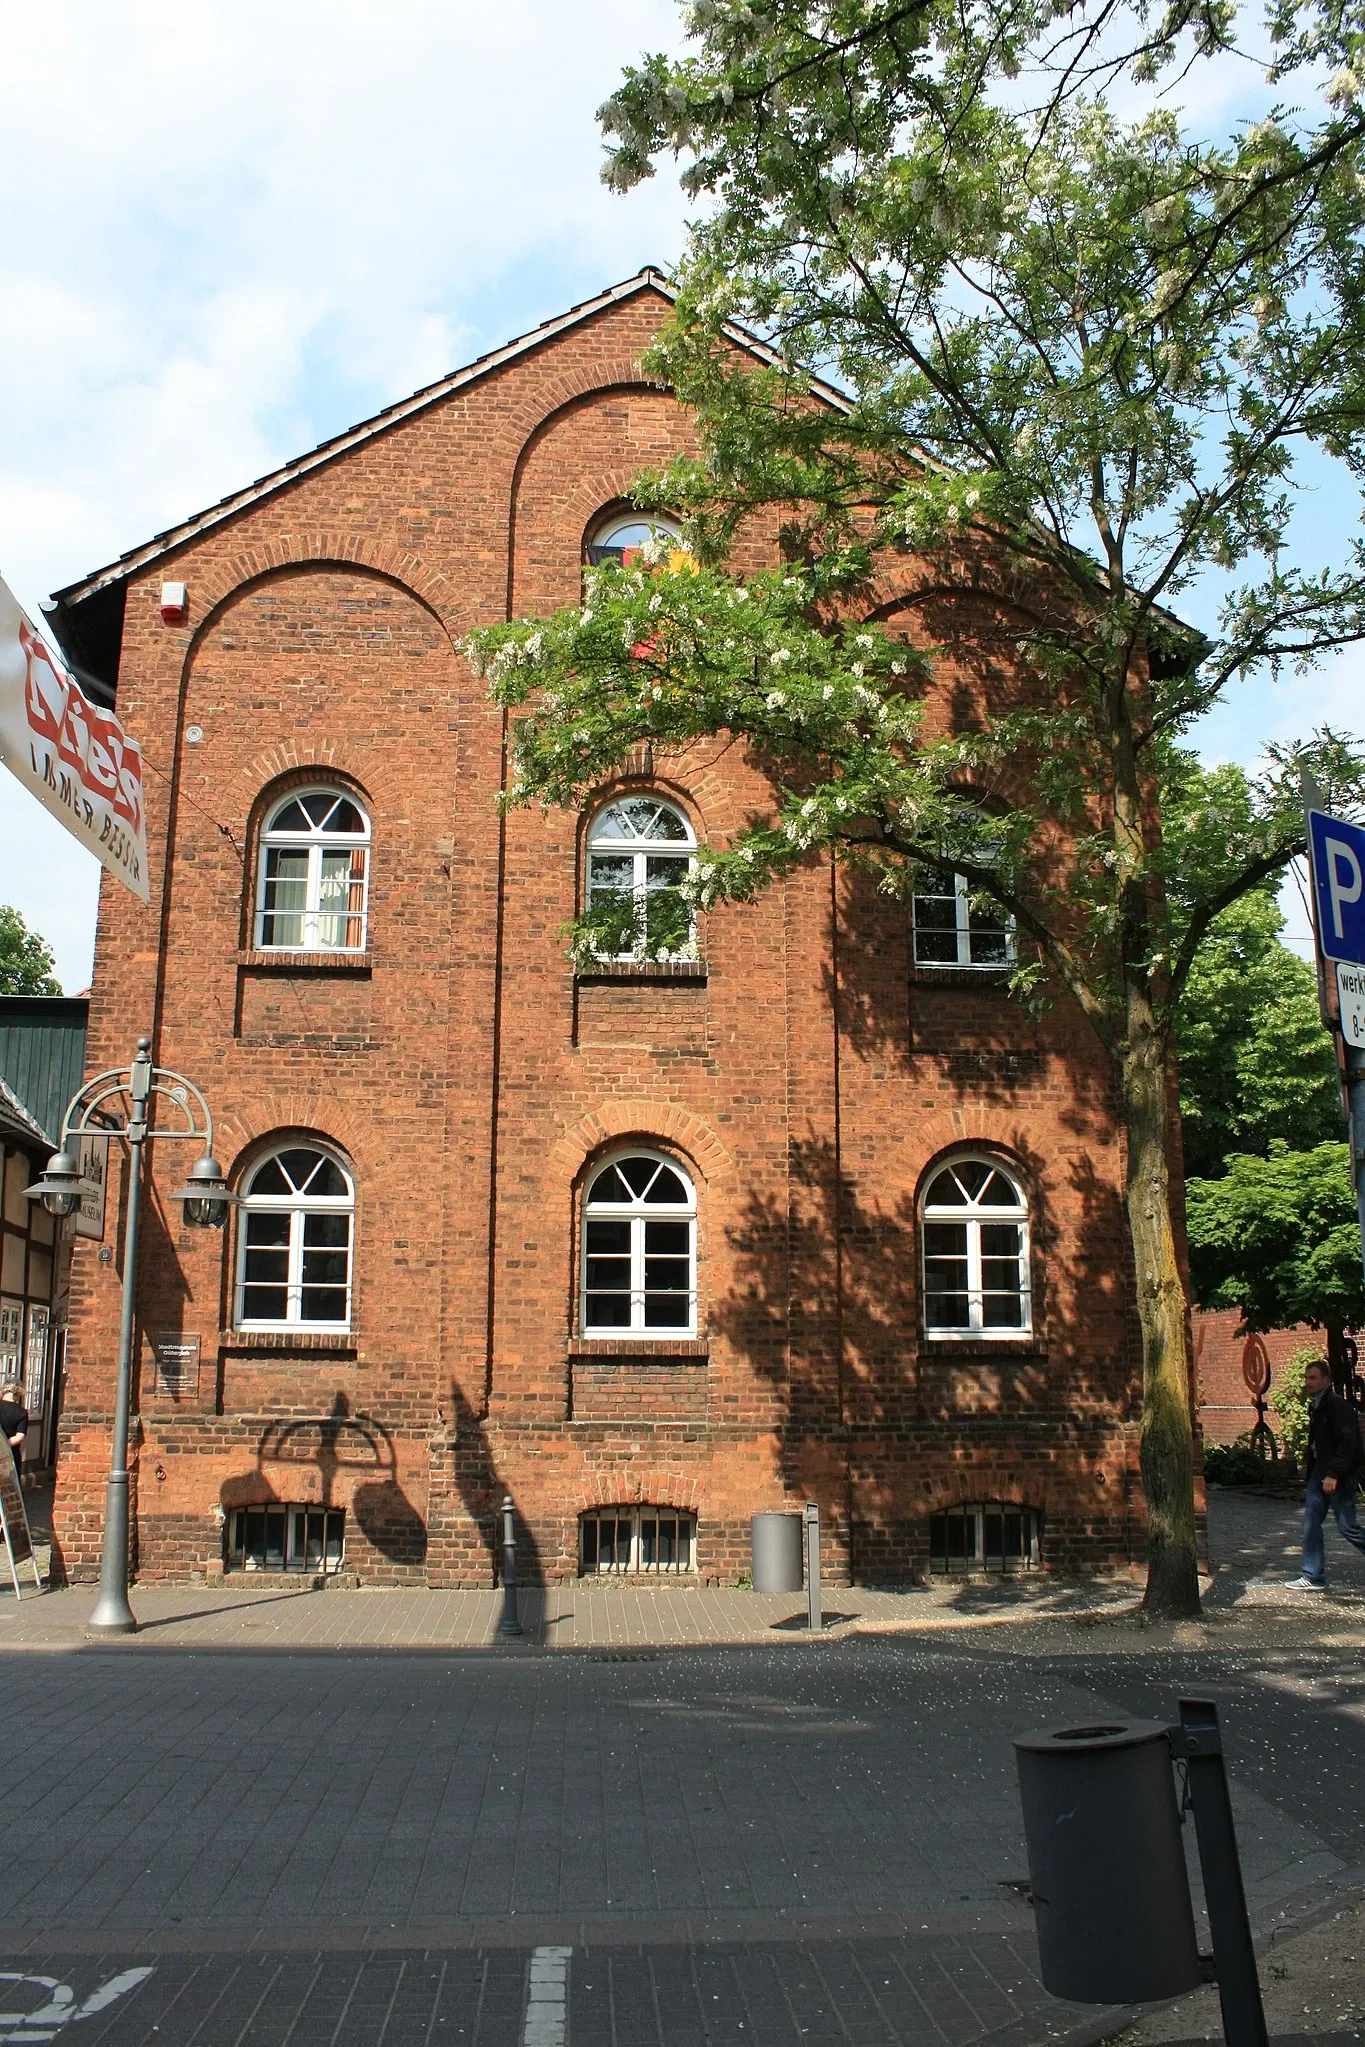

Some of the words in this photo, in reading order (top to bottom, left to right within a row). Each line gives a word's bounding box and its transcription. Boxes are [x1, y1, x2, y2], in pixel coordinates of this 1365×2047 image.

[30, 742, 94, 829] IMMER
[1325, 836, 1362, 939] P
[1340, 972, 1365, 996] werk
[1352, 1014, 1365, 1037] 8-
